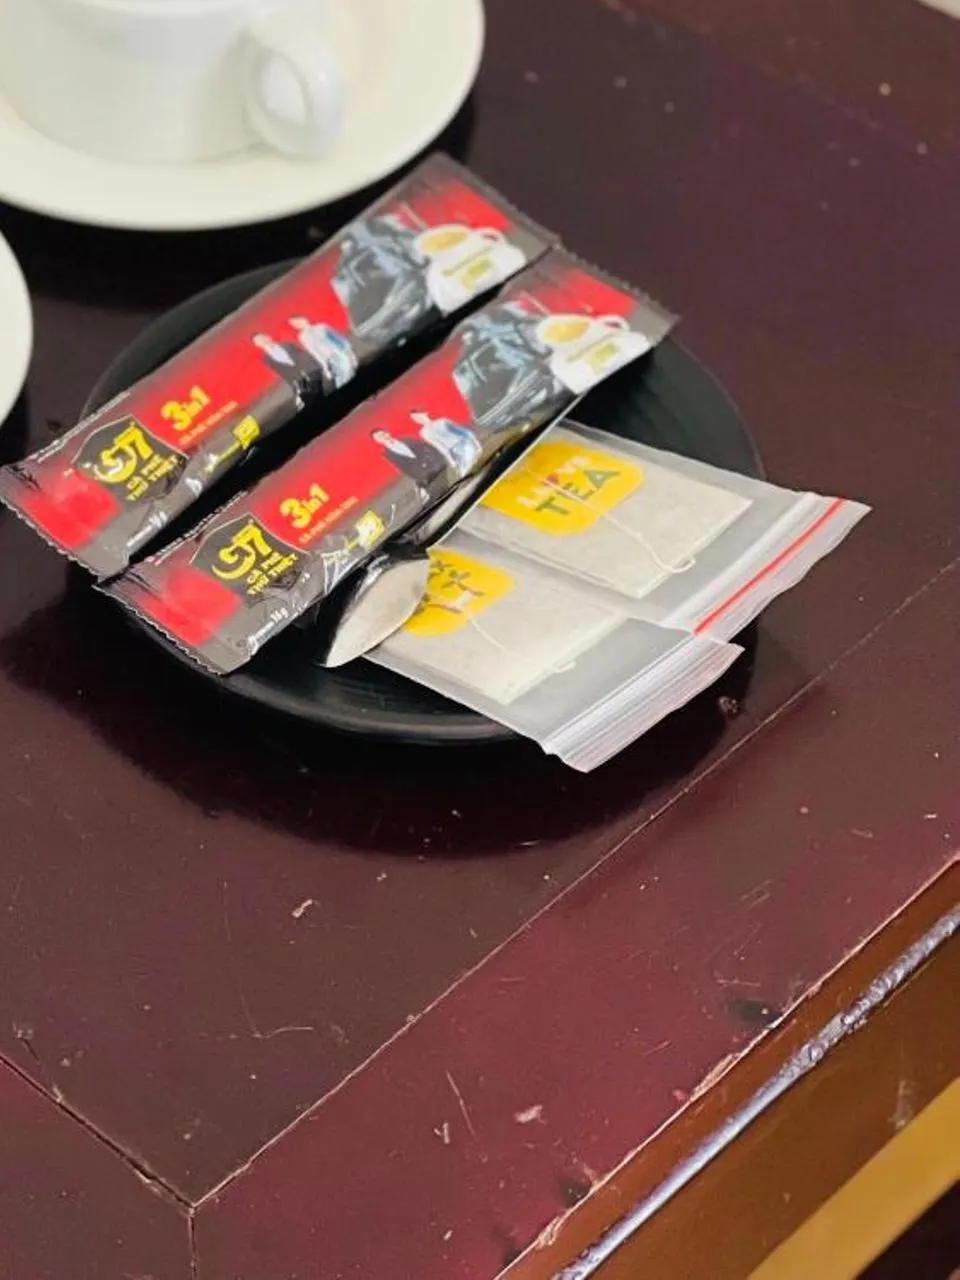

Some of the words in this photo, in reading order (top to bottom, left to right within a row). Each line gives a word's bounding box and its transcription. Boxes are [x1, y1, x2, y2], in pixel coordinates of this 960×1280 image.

[93, 424, 153, 483] G7
[280, 483, 330, 529] 3in1
[532, 468, 622, 516] TEA
[211, 523, 273, 580] G7
